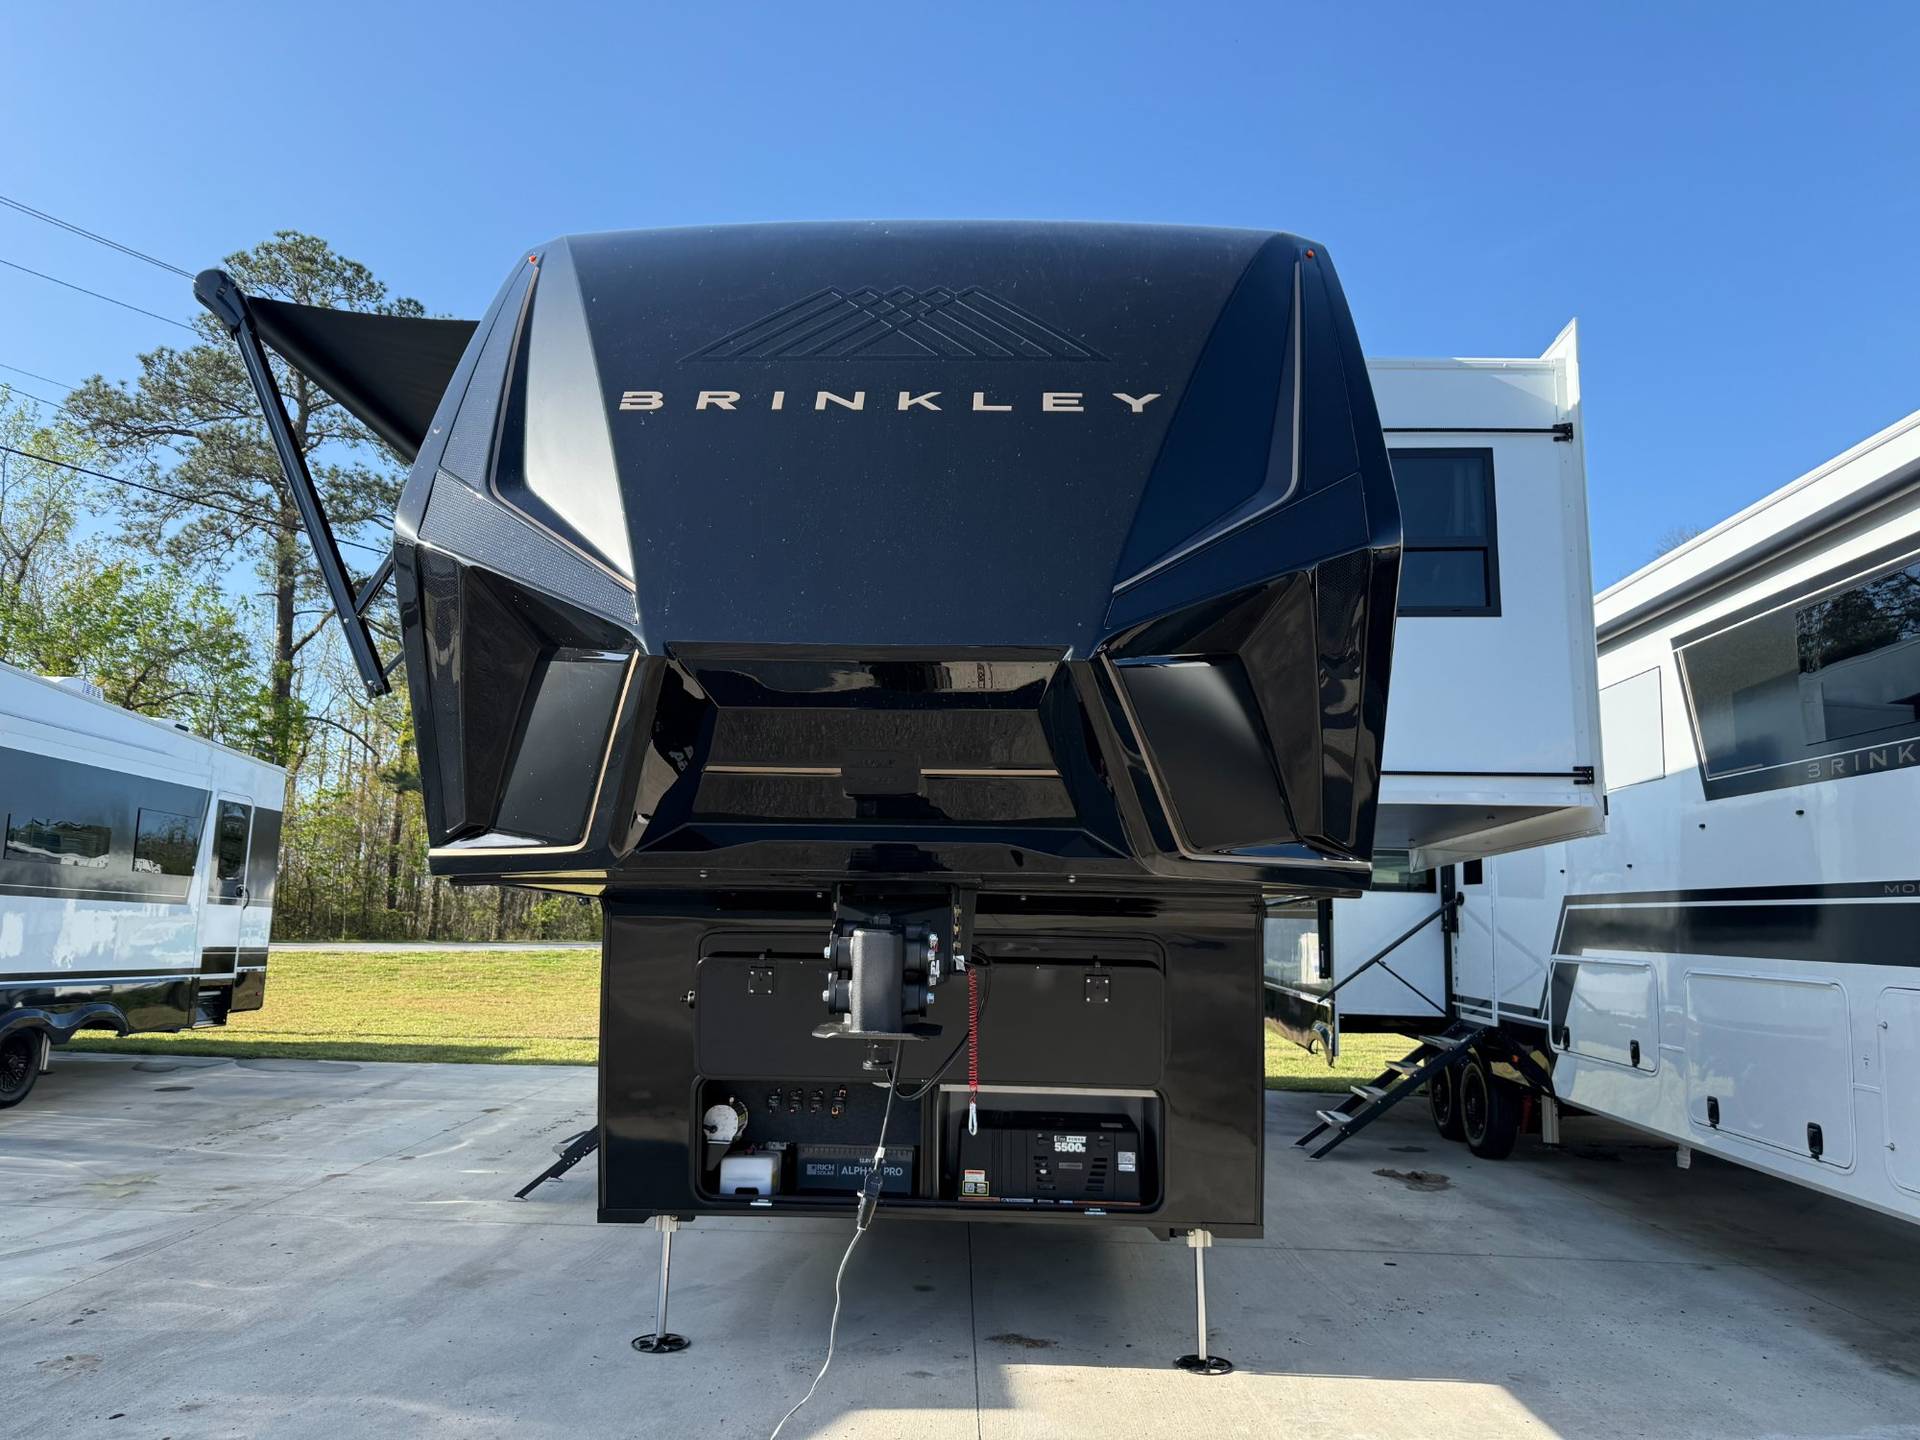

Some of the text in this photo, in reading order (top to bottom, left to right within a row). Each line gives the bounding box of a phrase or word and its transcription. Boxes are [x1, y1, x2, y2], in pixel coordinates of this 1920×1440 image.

[618, 390, 1162, 412] BRINKLEY
[1884, 883, 1920, 894] MO
[883, 1166, 903, 1176] PRO
